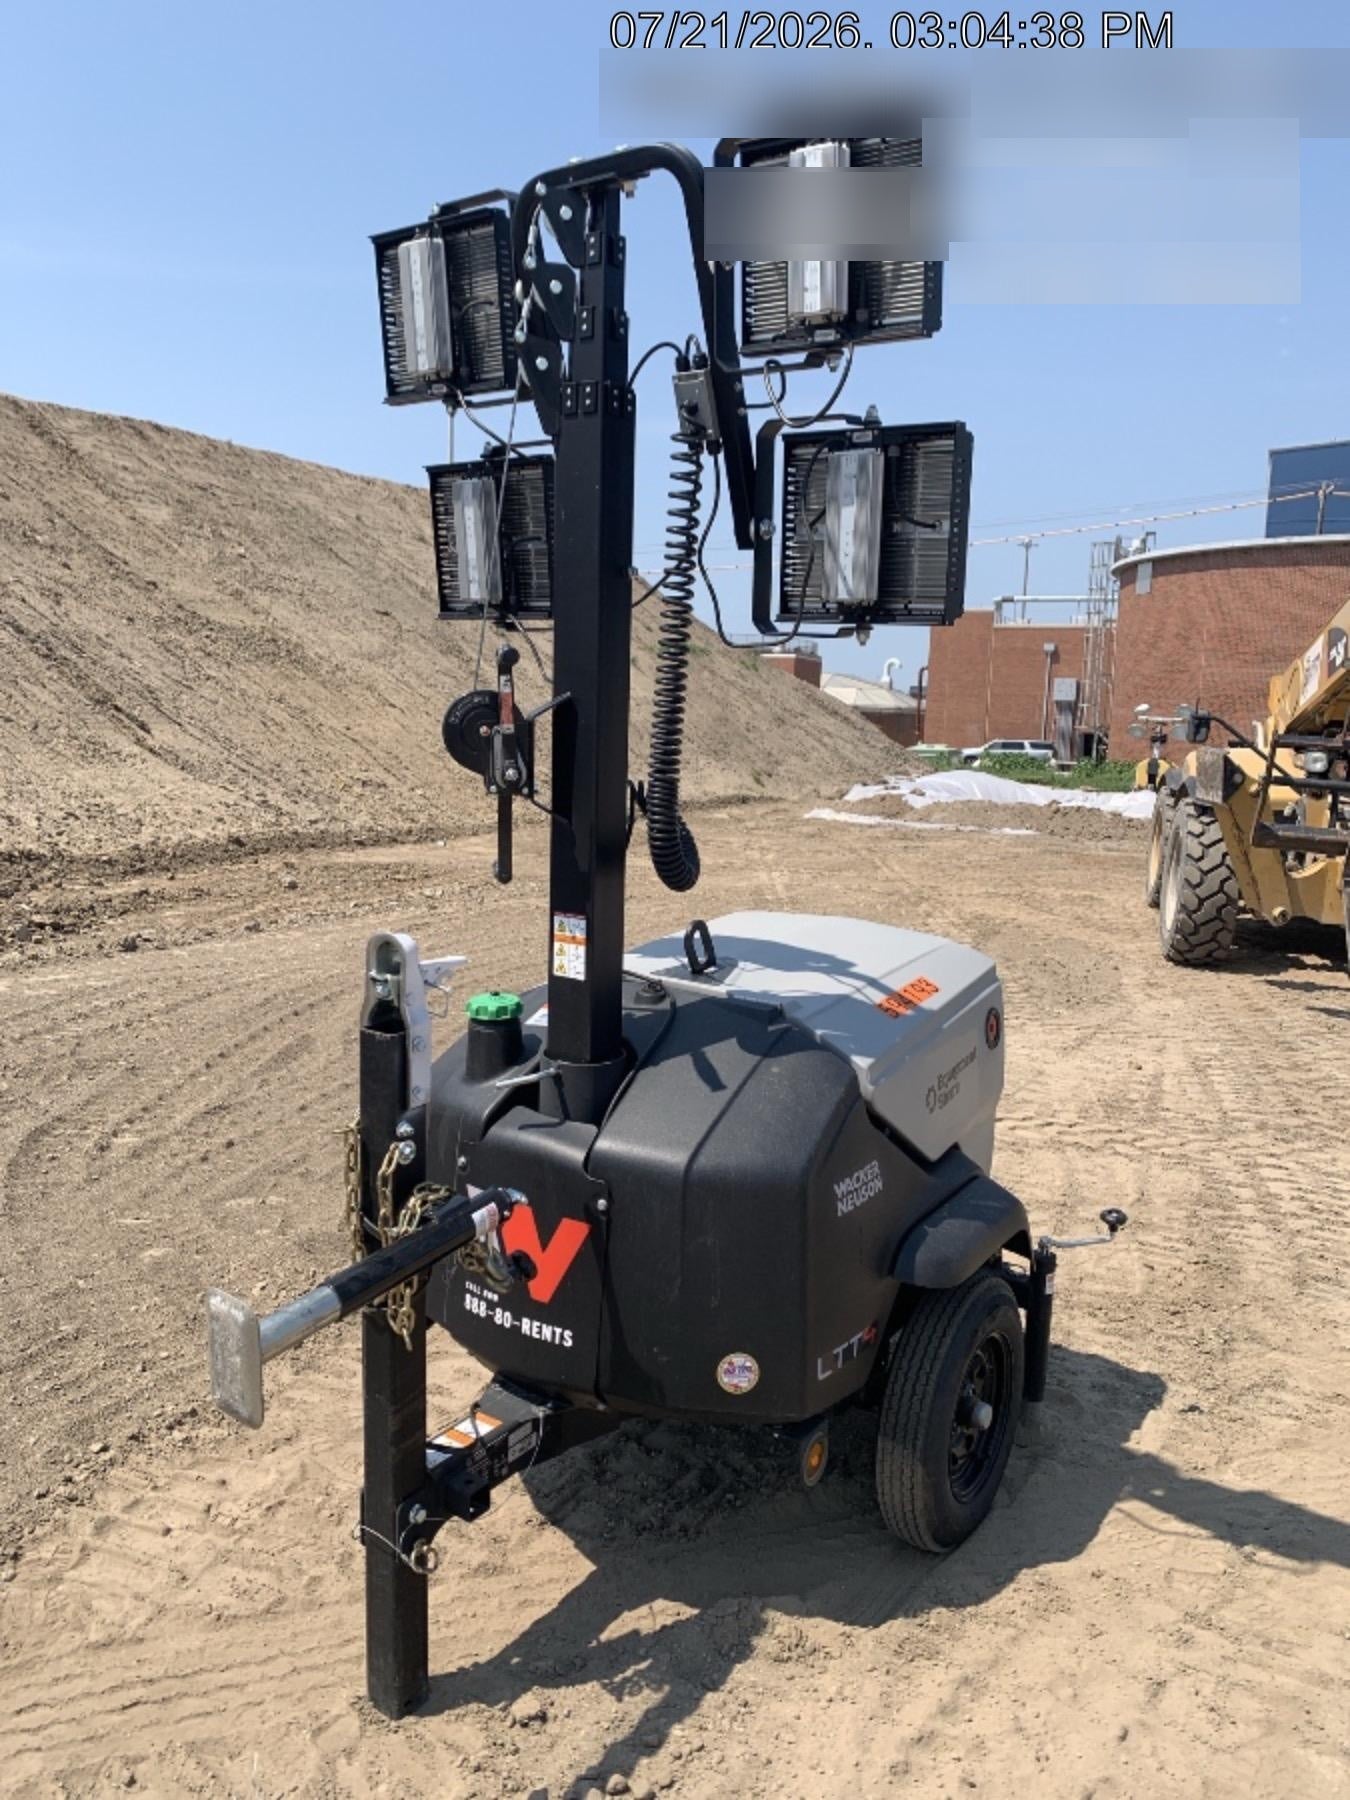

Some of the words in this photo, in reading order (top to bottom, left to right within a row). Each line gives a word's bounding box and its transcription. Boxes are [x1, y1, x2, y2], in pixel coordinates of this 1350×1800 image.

[833, 1160, 881, 1199] WACKER
[837, 1179, 883, 1216] NEUSON
[464, 1293, 574, 1348] 888-80-RENTS
